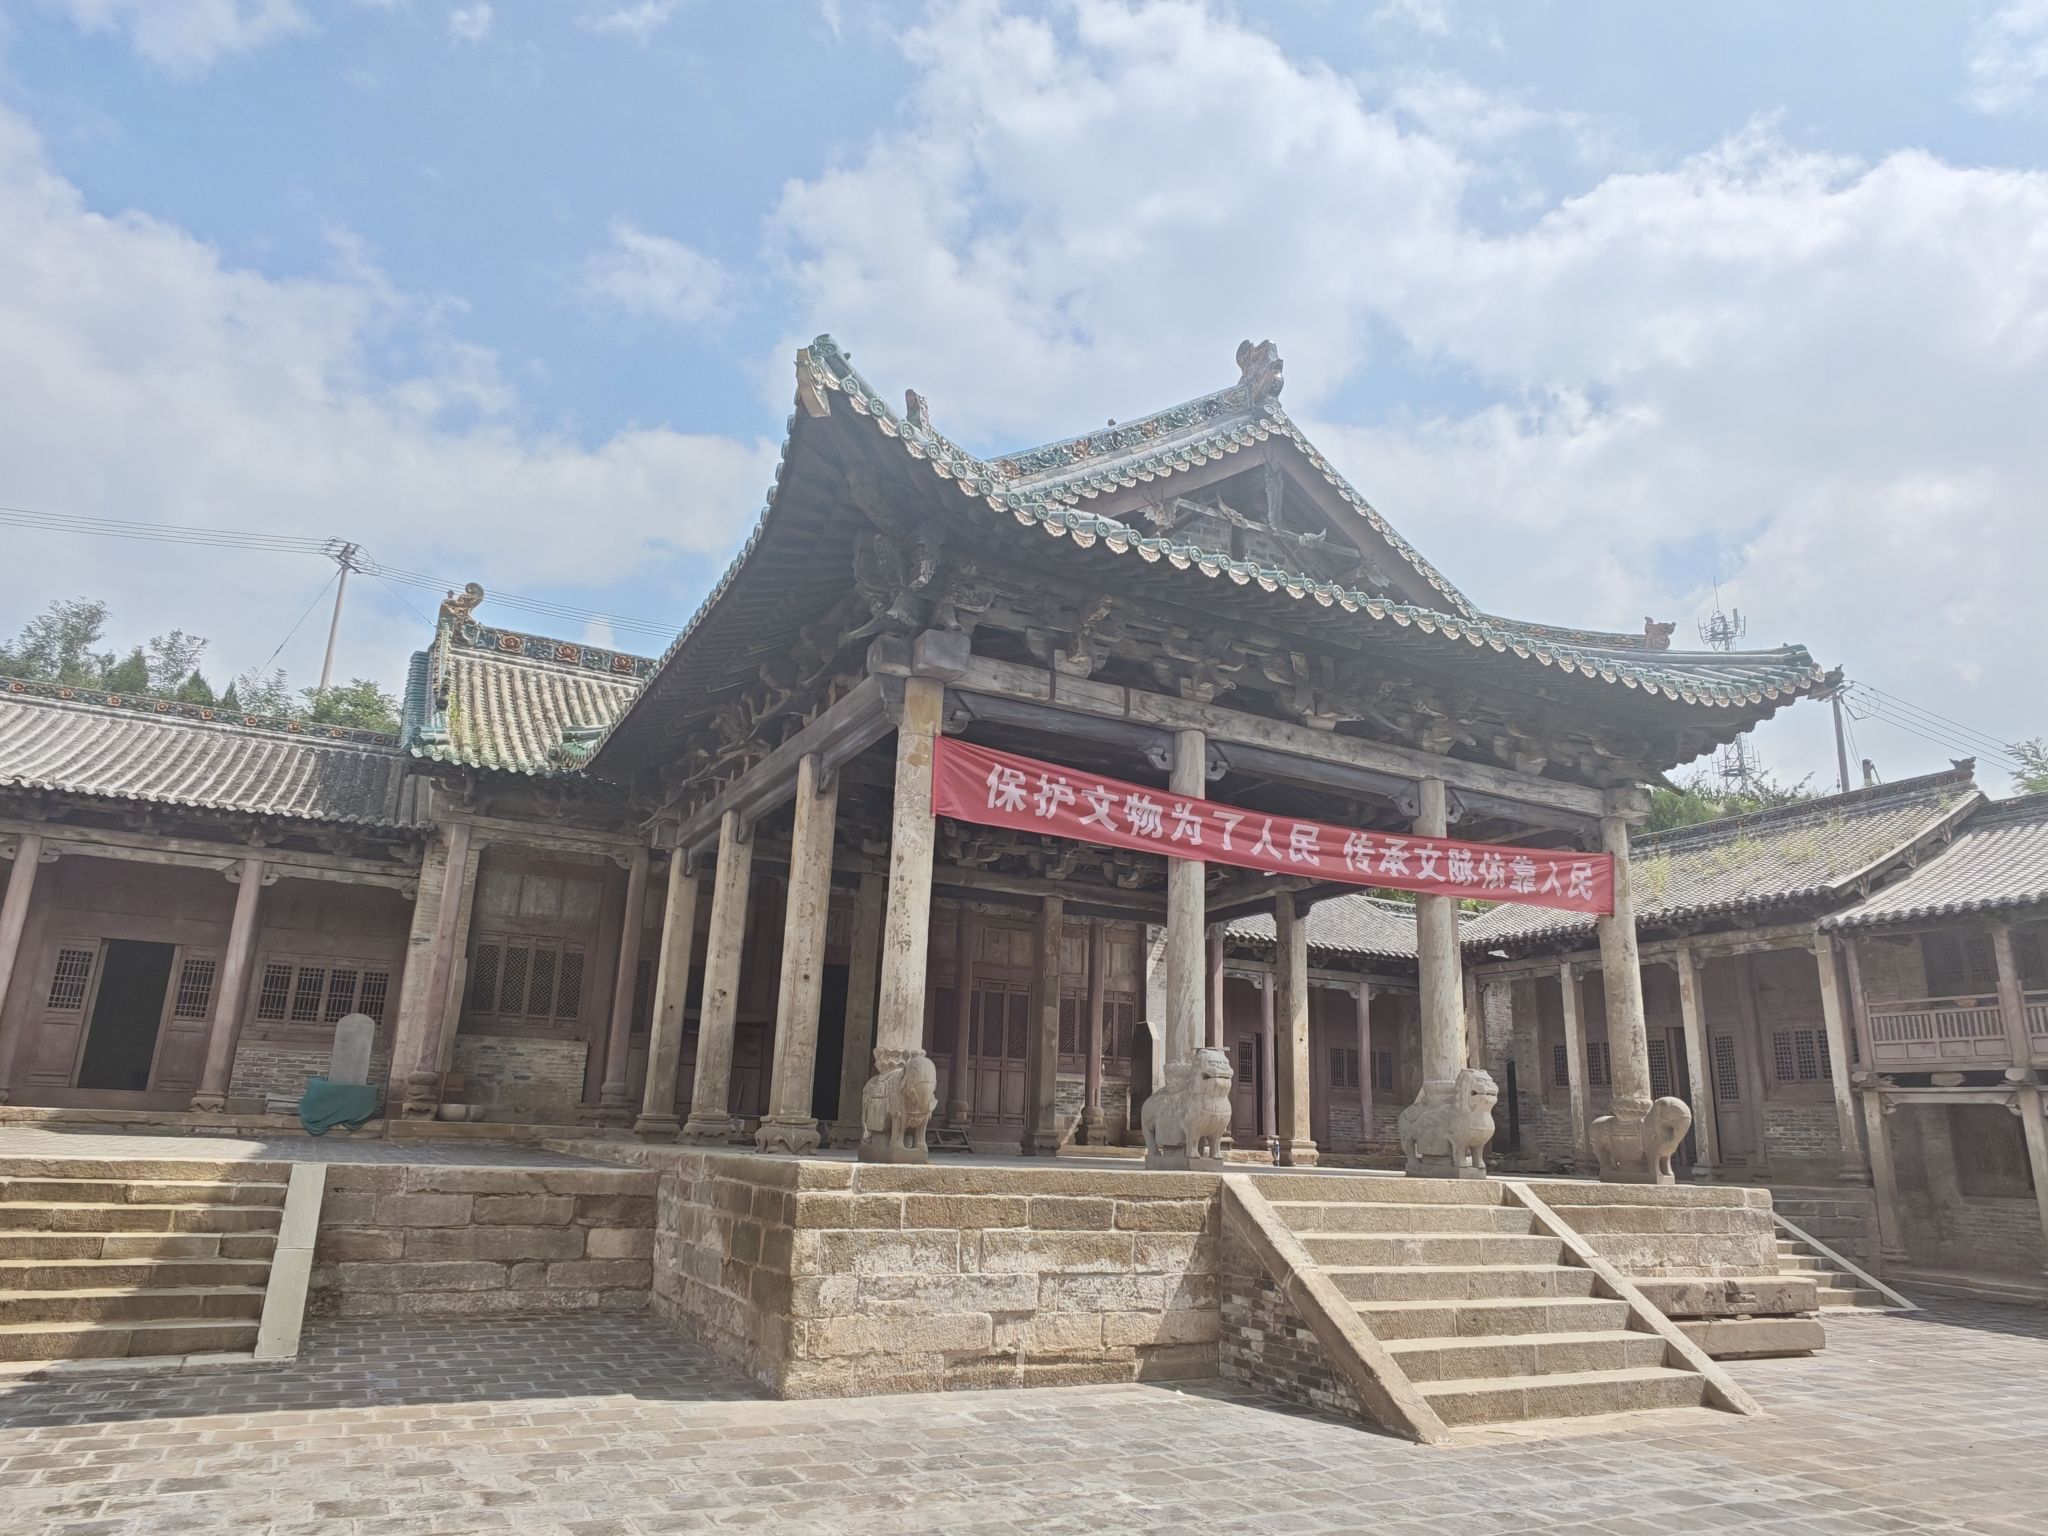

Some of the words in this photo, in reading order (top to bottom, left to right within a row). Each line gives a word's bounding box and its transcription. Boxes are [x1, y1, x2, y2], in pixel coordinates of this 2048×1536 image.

[985, 763, 1321, 866] 保护文物为了人民
[1343, 831, 1593, 901] 传承文脉依靠人民
